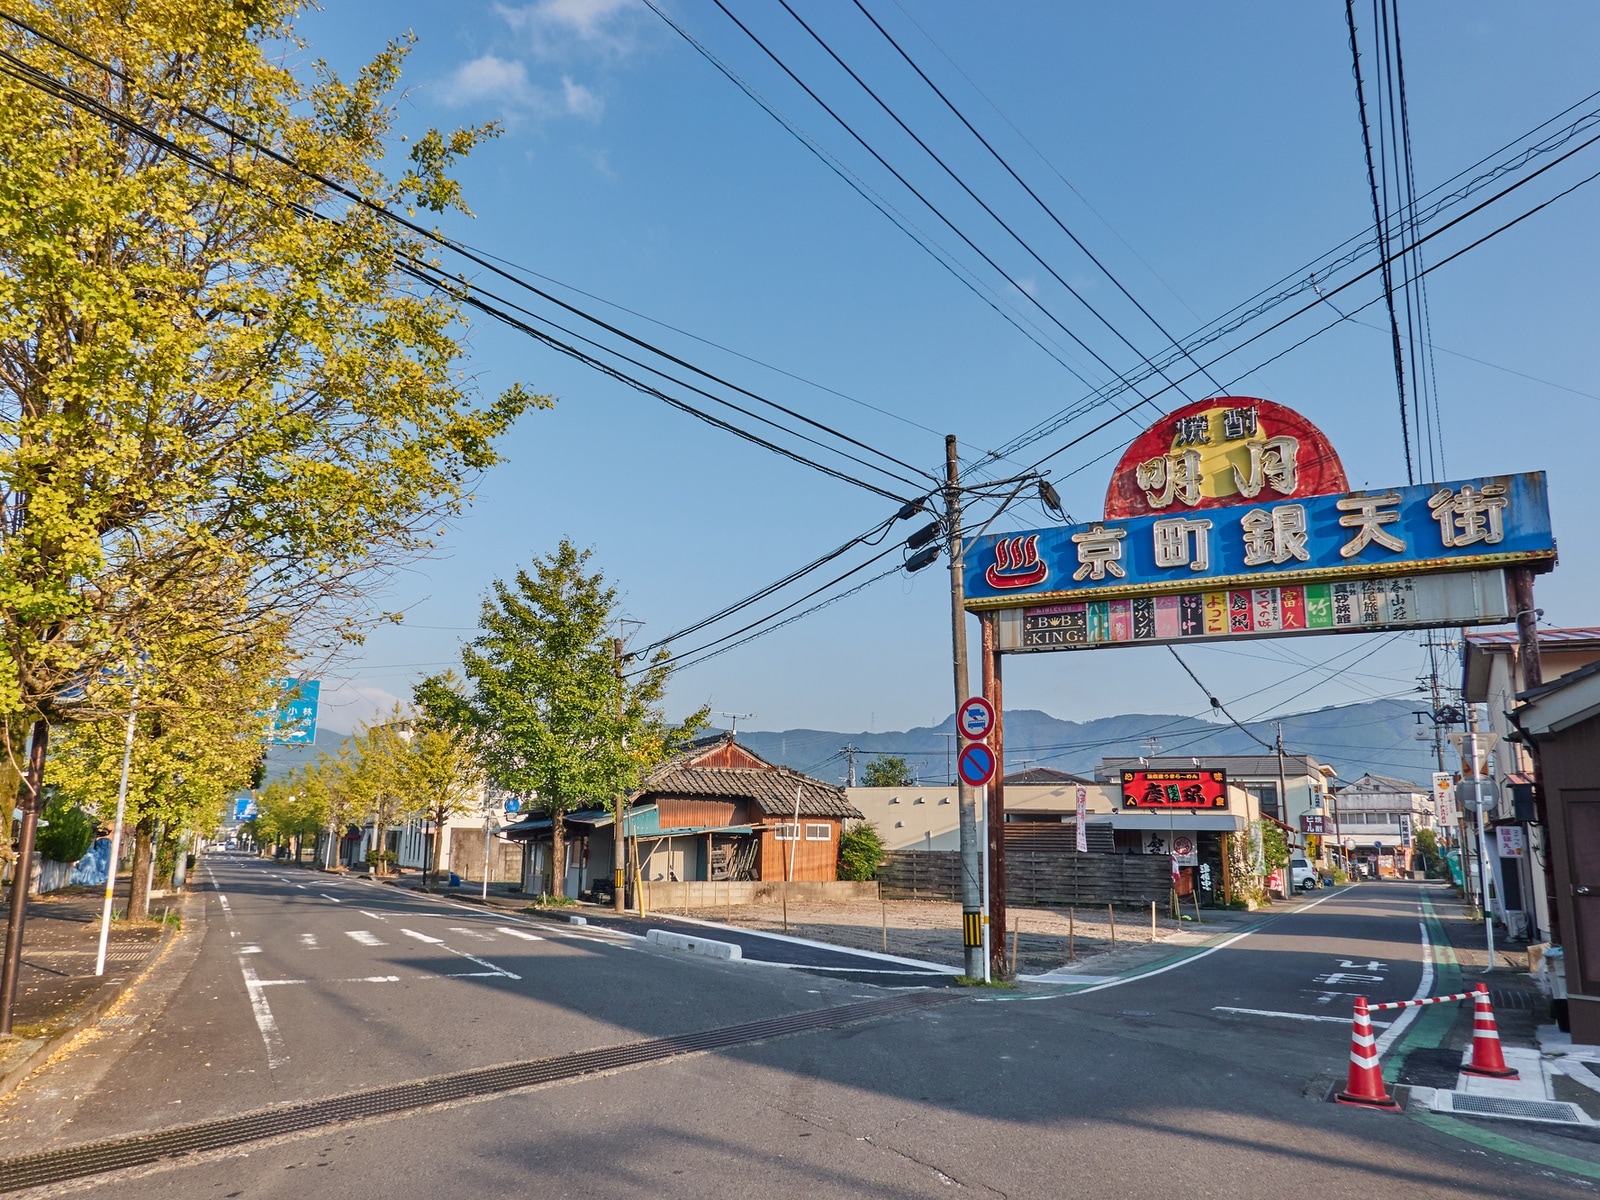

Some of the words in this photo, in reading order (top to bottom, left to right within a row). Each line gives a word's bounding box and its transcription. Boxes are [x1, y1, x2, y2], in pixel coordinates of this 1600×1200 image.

[1175, 405, 1260, 447] 焼酎
[1136, 435, 1299, 509] 明月
[1071, 484, 1508, 582] 京町銀天街
[1137, 598, 1149, 638] ジパング
[1255, 589, 1272, 629] ママの味
[1282, 590, 1300, 627] 富久
[1307, 598, 1330, 616] 竹
[1334, 583, 1352, 625] 真砂旅館
[1361, 581, 1378, 622] 松尾旅館
[1391, 580, 1407, 621] 春山荘
[1032, 630, 1078, 644] KING
[287, 706, 313, 716] 小林
[1306, 816, 1314, 832] ビール
